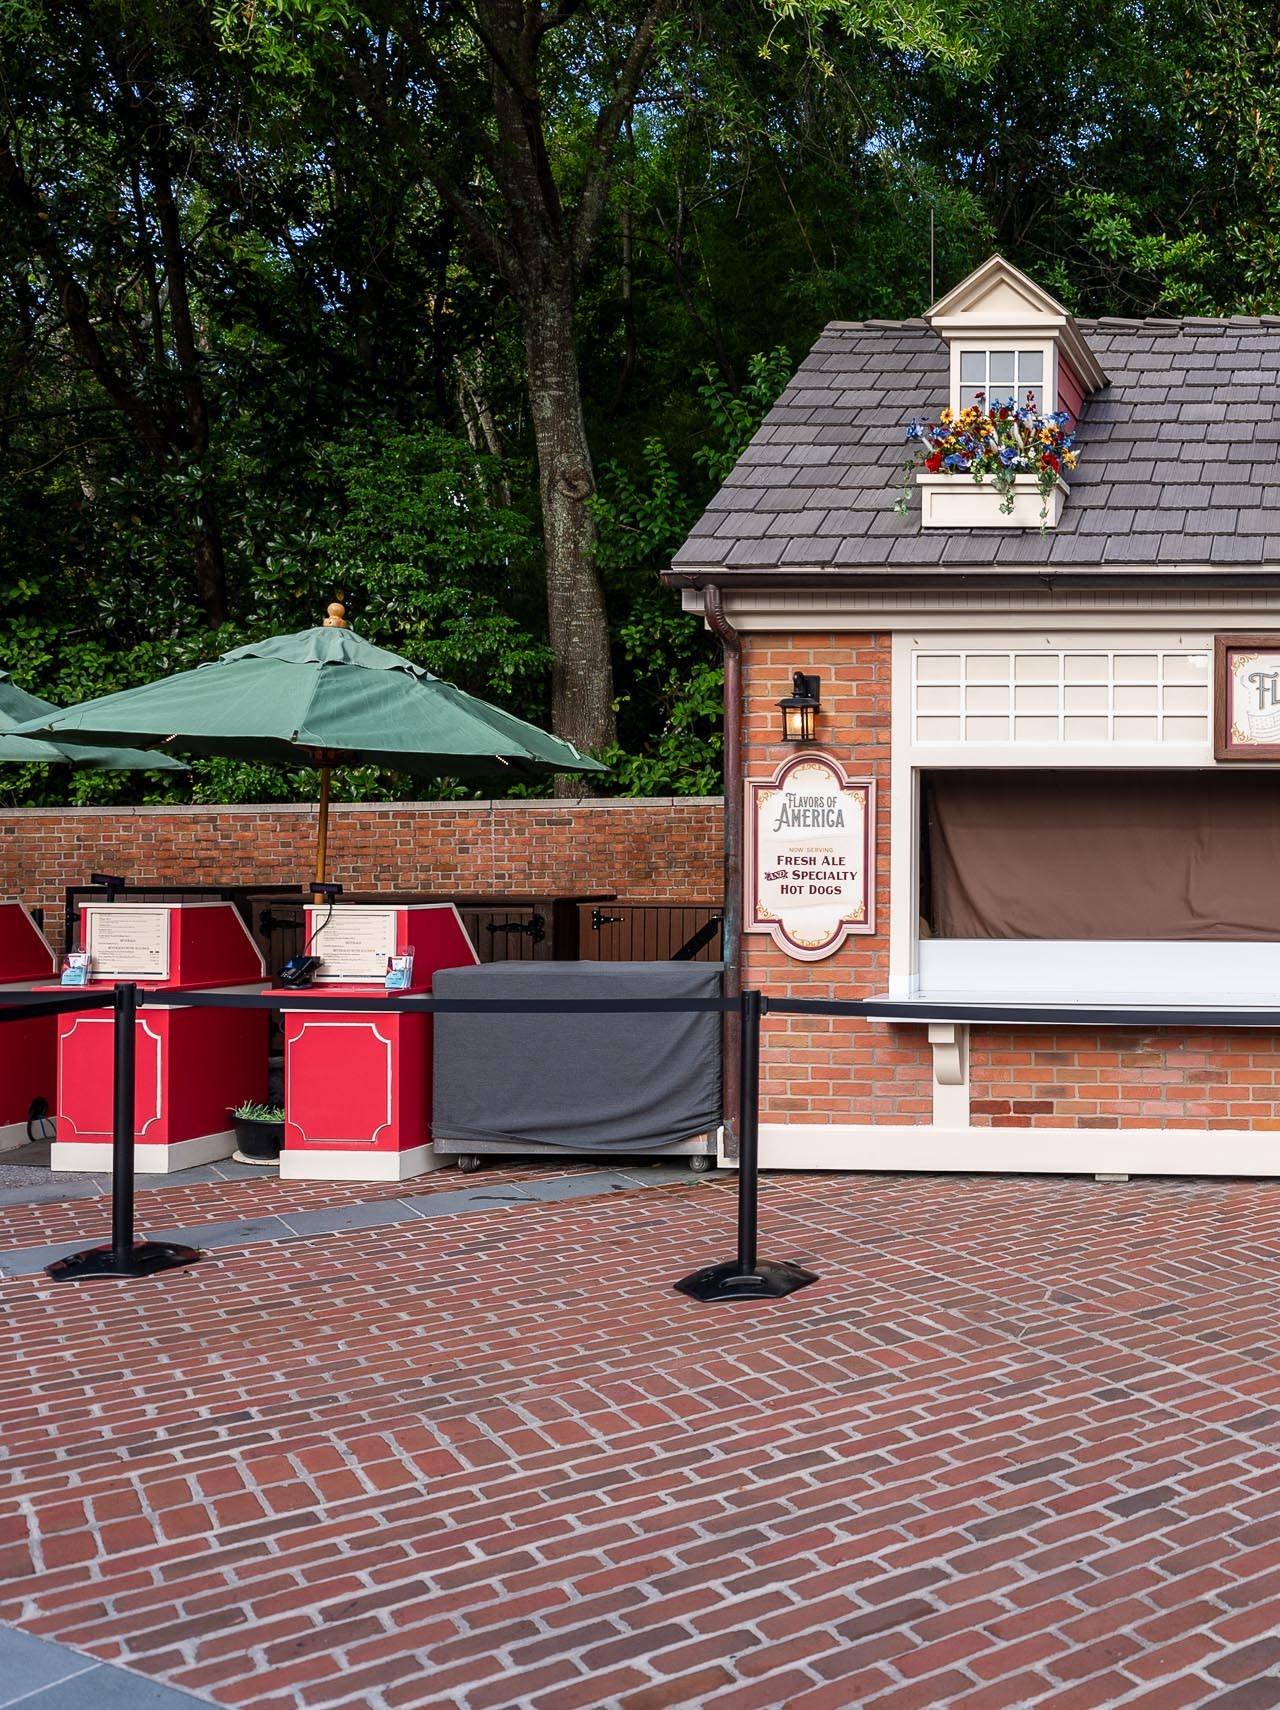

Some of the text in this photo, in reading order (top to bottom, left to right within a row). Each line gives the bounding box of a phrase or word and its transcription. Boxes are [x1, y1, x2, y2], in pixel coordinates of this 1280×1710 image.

[785, 792, 838, 809] FLAVORS OF
[772, 802, 845, 833] AMERICA
[777, 855, 846, 866] FRESH ALE
[767, 869, 858, 881] AND SPECIALTY
[780, 884, 842, 895] HOT DOGS
